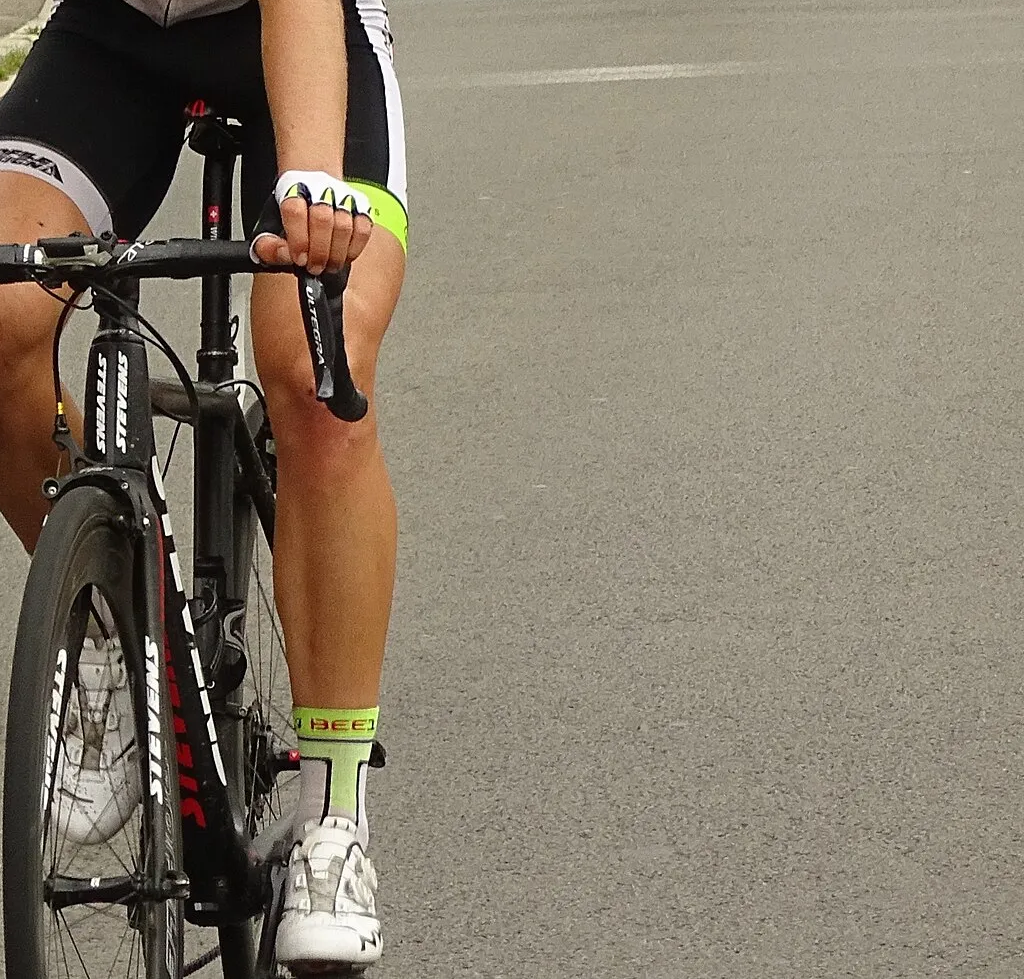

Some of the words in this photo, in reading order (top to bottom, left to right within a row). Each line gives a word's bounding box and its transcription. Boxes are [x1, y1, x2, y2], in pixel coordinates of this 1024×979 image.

[306, 285, 325, 365] ULTEGRA
[96, 352, 106, 454] STEVENS
[116, 350, 128, 454] STEVENS
[145, 635, 163, 805] STEVENS
